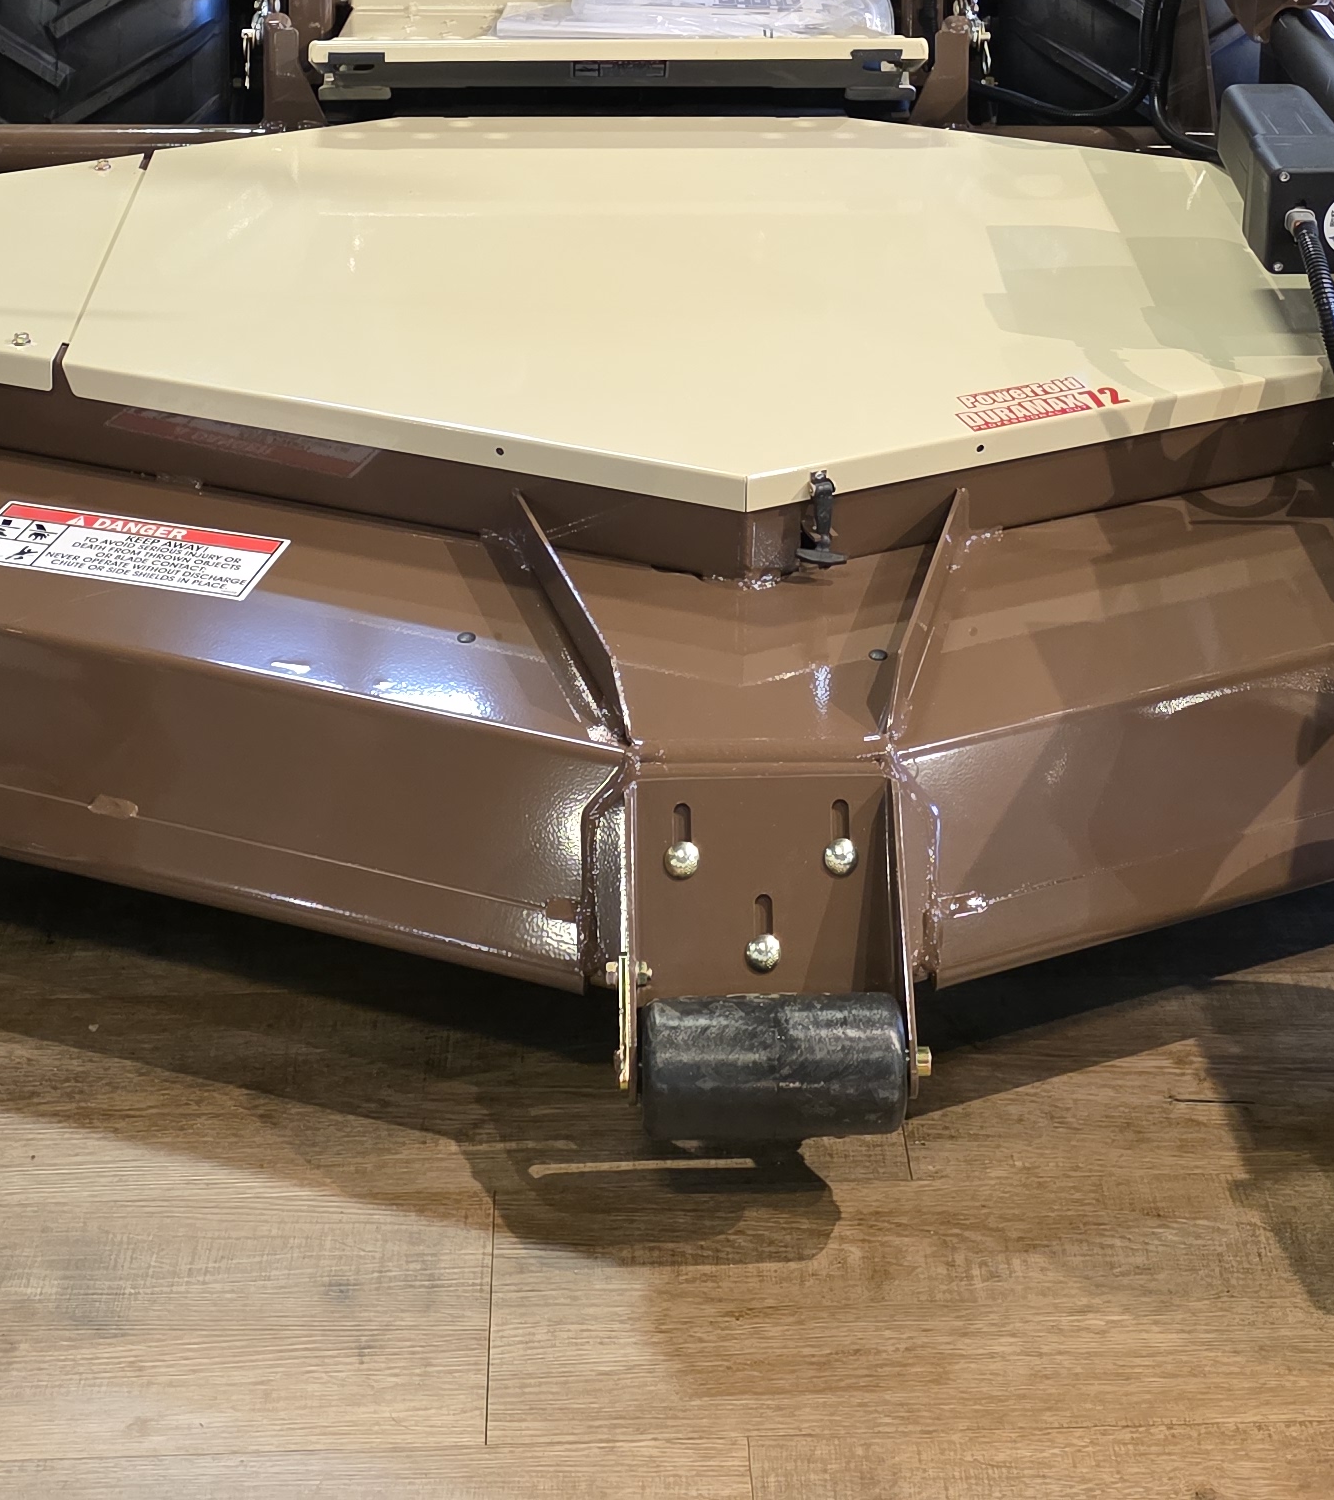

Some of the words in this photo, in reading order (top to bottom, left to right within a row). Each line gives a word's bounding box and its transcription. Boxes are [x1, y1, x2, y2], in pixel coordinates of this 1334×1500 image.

[1078, 387, 1131, 409] 72
[92, 518, 187, 540] DANGER
[71, 541, 107, 552] DEATH
[111, 546, 142, 557] FROM
[143, 551, 192, 563] THROWN
[193, 558, 242, 571] OBJECTS
[84, 536, 99, 544] TO
[100, 538, 135, 549] AVOID
[139, 543, 183, 555] SERIOUS
[185, 550, 223, 561] INJURY
[224, 556, 242, 564] OR
[125, 536, 161, 545] KEEP
[166, 541, 208, 553] AWAY!
[44, 551, 80, 562] NEVER
[82, 556, 130, 569] OPERATE
[132, 563, 182, 576] WITHOUT
[182, 571, 248, 586] DISCHARGE
[95, 551, 113, 560] OR
[114, 554, 148, 565] BLADE
[50, 559, 85, 569] CHUTE
[87, 564, 105, 572] OR
[106, 566, 131, 576] SIDE
[132, 570, 176, 582] SHIELDS
[191, 580, 228, 590] PLACE.
